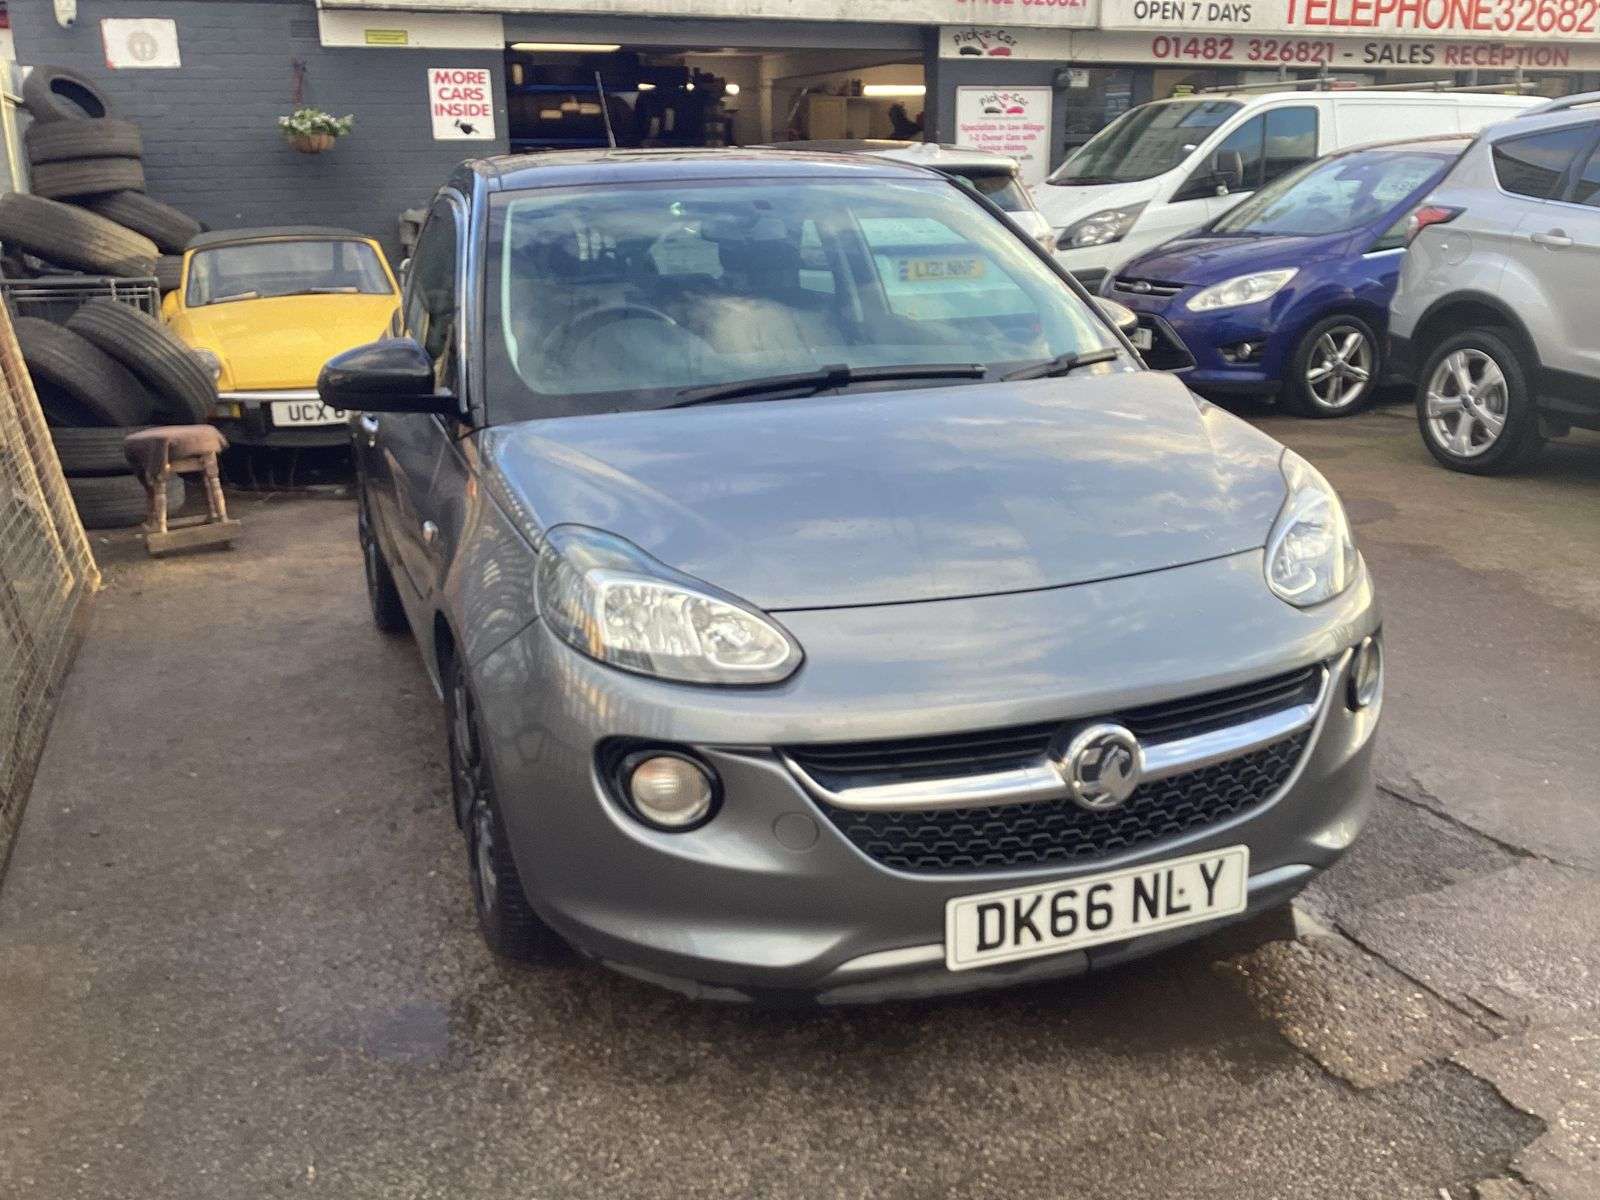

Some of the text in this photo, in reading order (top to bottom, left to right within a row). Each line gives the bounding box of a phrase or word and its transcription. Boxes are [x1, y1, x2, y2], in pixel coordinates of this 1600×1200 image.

[1134, 1, 1251, 22] OPEN 7 DAYS
[1287, 0, 1600, 33] TELEPHONE32682
[1152, 35, 1234, 60] 01482
[1248, 38, 1335, 62] 326821
[1364, 43, 1435, 65] SALES
[1444, 45, 1569, 66] RECEPTION
[434, 71, 486, 84] MORE
[438, 87, 484, 100] CARS
[434, 103, 490, 116] INSIDE
[288, 404, 327, 421] UCX
[976, 859, 1224, 953] DK66 NLY
